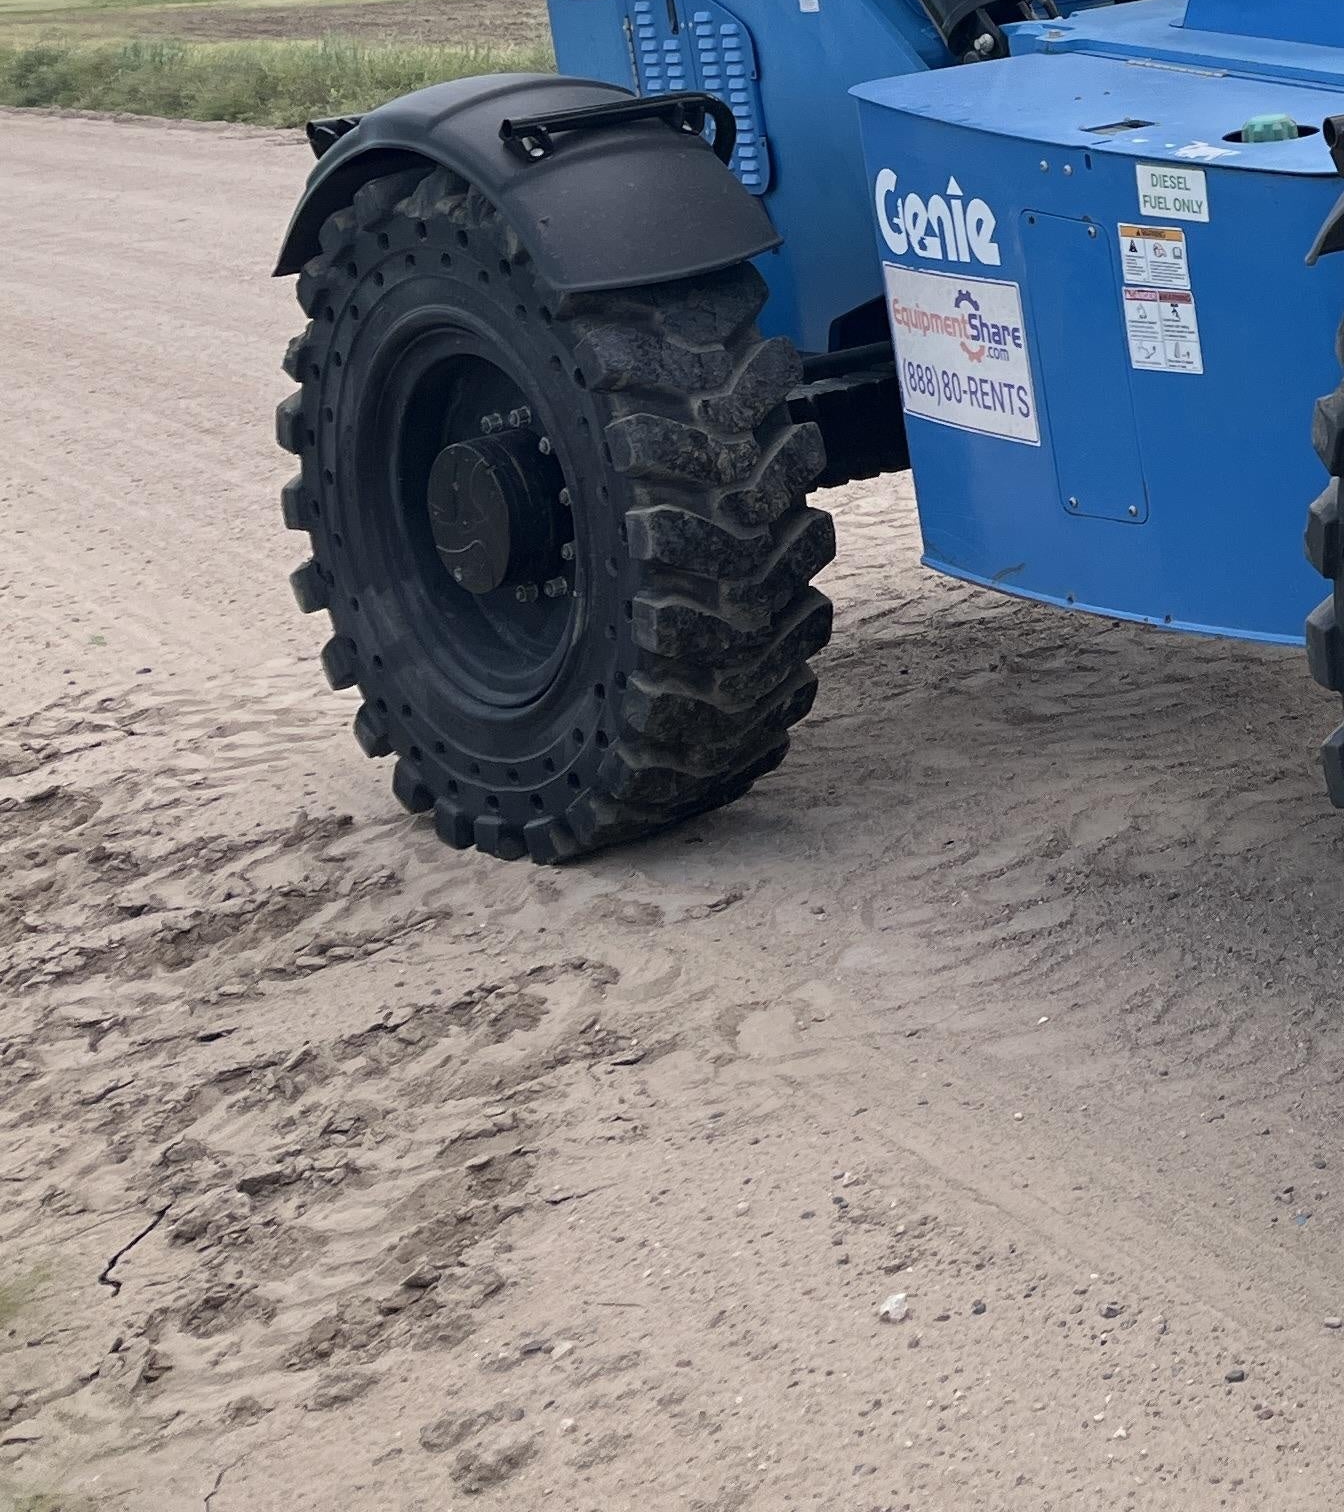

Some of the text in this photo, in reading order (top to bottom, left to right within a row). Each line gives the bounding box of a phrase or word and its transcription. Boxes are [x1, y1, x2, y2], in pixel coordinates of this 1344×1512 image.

[1150, 173, 1191, 191] DIESEL
[875, 168, 1001, 265] Genie
[1142, 194, 1204, 215] FUEL ONLY
[892, 297, 1023, 349] EquipmentShare
[986, 343, 1010, 362] .com
[903, 357, 1031, 419] (888) 80-RENTS
